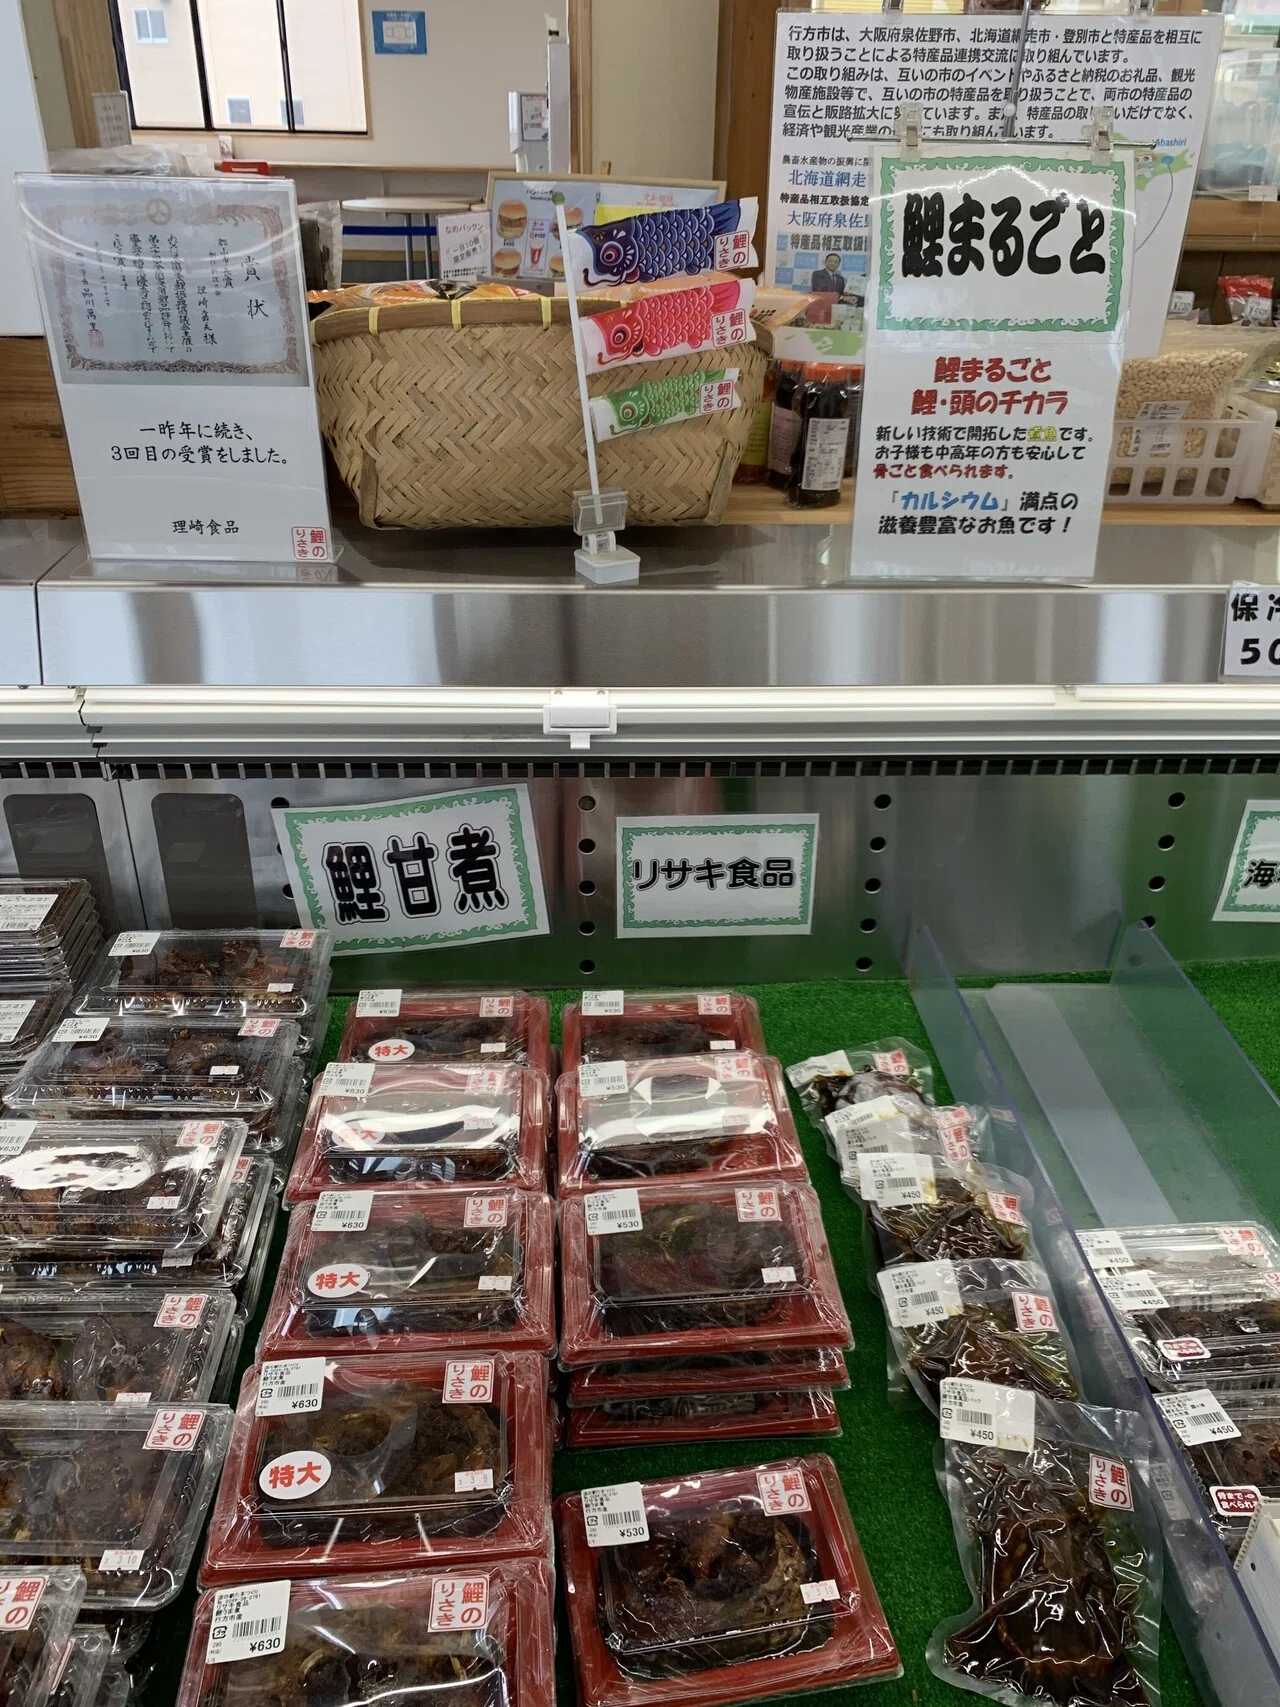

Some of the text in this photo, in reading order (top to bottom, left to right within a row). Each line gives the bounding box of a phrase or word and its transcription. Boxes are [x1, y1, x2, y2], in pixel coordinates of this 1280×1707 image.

[783, 103, 1194, 121] 宣伝と販路拡大にています。ま、特産品の取いだけでなく、
[782, 122, 1054, 139] 経済や観光産業のにも取り組んいます。
[789, 170, 866, 187] 北海道網走
[732, 233, 748, 265] 鯉の
[902, 192, 1106, 279] 鯉まるごと
[717, 235, 732, 270] りさき
[713, 313, 728, 346] りさき
[728, 310, 745, 342] 鯉の
[933, 356, 1052, 384] 鯉まるごと
[702, 384, 715, 412] りさき
[716, 381, 733, 409] 鯉の
[910, 389, 1069, 416] 鯉・頭のチカラ
[139, 420, 254, 442] 一昨年に続き、
[875, 425, 1094, 443] 新しい技術で開拓した煮魚です。
[111, 444, 289, 465] 3回目の受賞をしました。
[874, 445, 1086, 461] お子様も中高年の方も安心して
[873, 463, 1014, 480] 骨ごと食べられます。
[172, 519, 240, 536] 理崎食品
[877, 515, 1072, 536] 滋養豊富なお魚です！
[294, 528, 309, 559] りさき
[309, 528, 326, 558] 鯉の
[322, 824, 510, 926] 鯉甘煮
[631, 856, 799, 892] リサキ食品
[1241, 858, 1280, 888] 海
[374, 1045, 409, 1058] 特大
[345, 1087, 365, 1095] ¥630
[200, 1122, 222, 1145] 鯉の
[757, 1191, 777, 1218] 鯉の
[901, 1190, 921, 1199] ¥450
[470, 1198, 486, 1225] りさき
[487, 1198, 504, 1223] 鯉の
[616, 1220, 640, 1229] ¥530
[341, 1221, 365, 1229] ¥630
[315, 1271, 361, 1291] 特大
[161, 1296, 180, 1324] りさき
[180, 1296, 204, 1325] 鯉の
[924, 1305, 944, 1317] ¥450
[1018, 1295, 1037, 1329] りさき
[1033, 1297, 1054, 1327] 鯉の
[448, 1364, 467, 1400] りさき
[469, 1364, 490, 1398] 鯉の
[291, 1398, 319, 1409] ¥630
[151, 1412, 177, 1446] りさき
[173, 1413, 201, 1447] 鯉の
[970, 1428, 994, 1441] ¥450
[1208, 1425, 1236, 1436] ¥450
[269, 1461, 322, 1489] 特大
[1094, 1459, 1108, 1502] りさき
[1109, 1464, 1128, 1505] 鯉の
[765, 1476, 783, 1512] りさき
[782, 1473, 805, 1508] 鯉の
[619, 1526, 645, 1538] ¥530
[5, 1581, 41, 1625] 鯉の
[436, 1583, 457, 1627] りさき
[460, 1582, 486, 1625] 鯉の
[249, 1636, 281, 1653] ¥630
